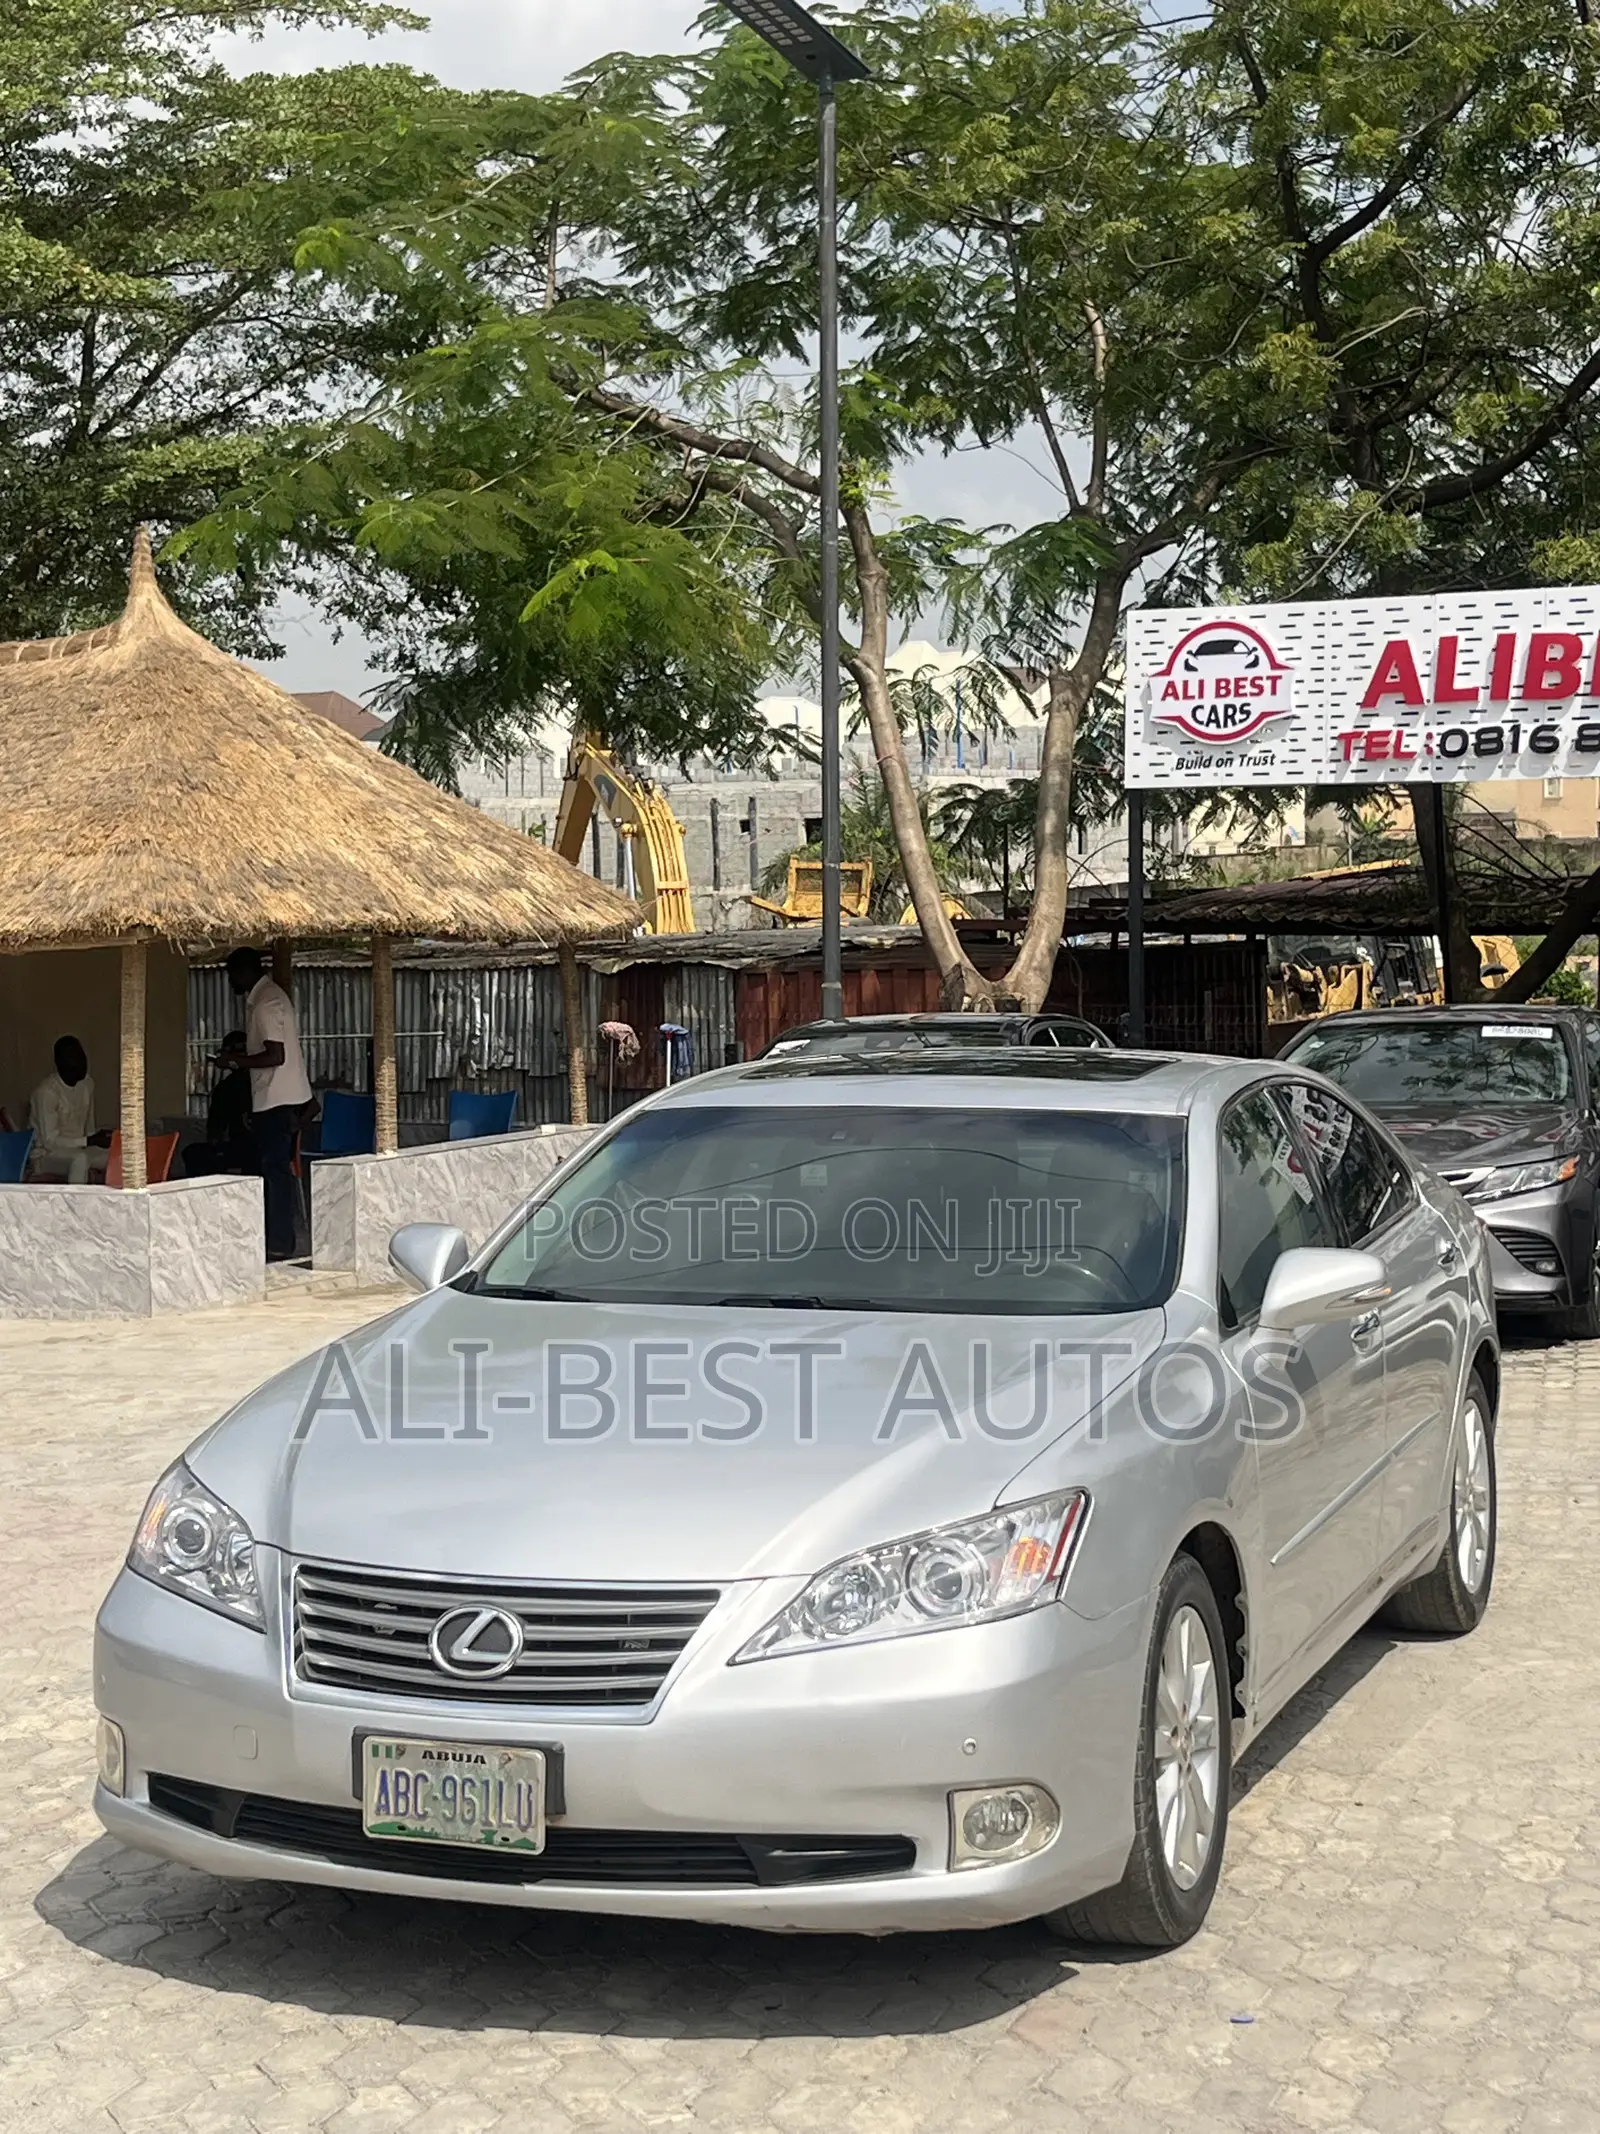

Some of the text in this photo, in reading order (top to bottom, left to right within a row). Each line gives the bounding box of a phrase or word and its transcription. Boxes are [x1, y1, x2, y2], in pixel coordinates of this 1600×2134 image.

[1360, 632, 1600, 708] ALIB
[1160, 675, 1283, 702] ALI BEST
[1191, 702, 1252, 729] CARS
[1175, 753, 1277, 771] Build on Trust
[422, 1750, 486, 1764] ABUJA
